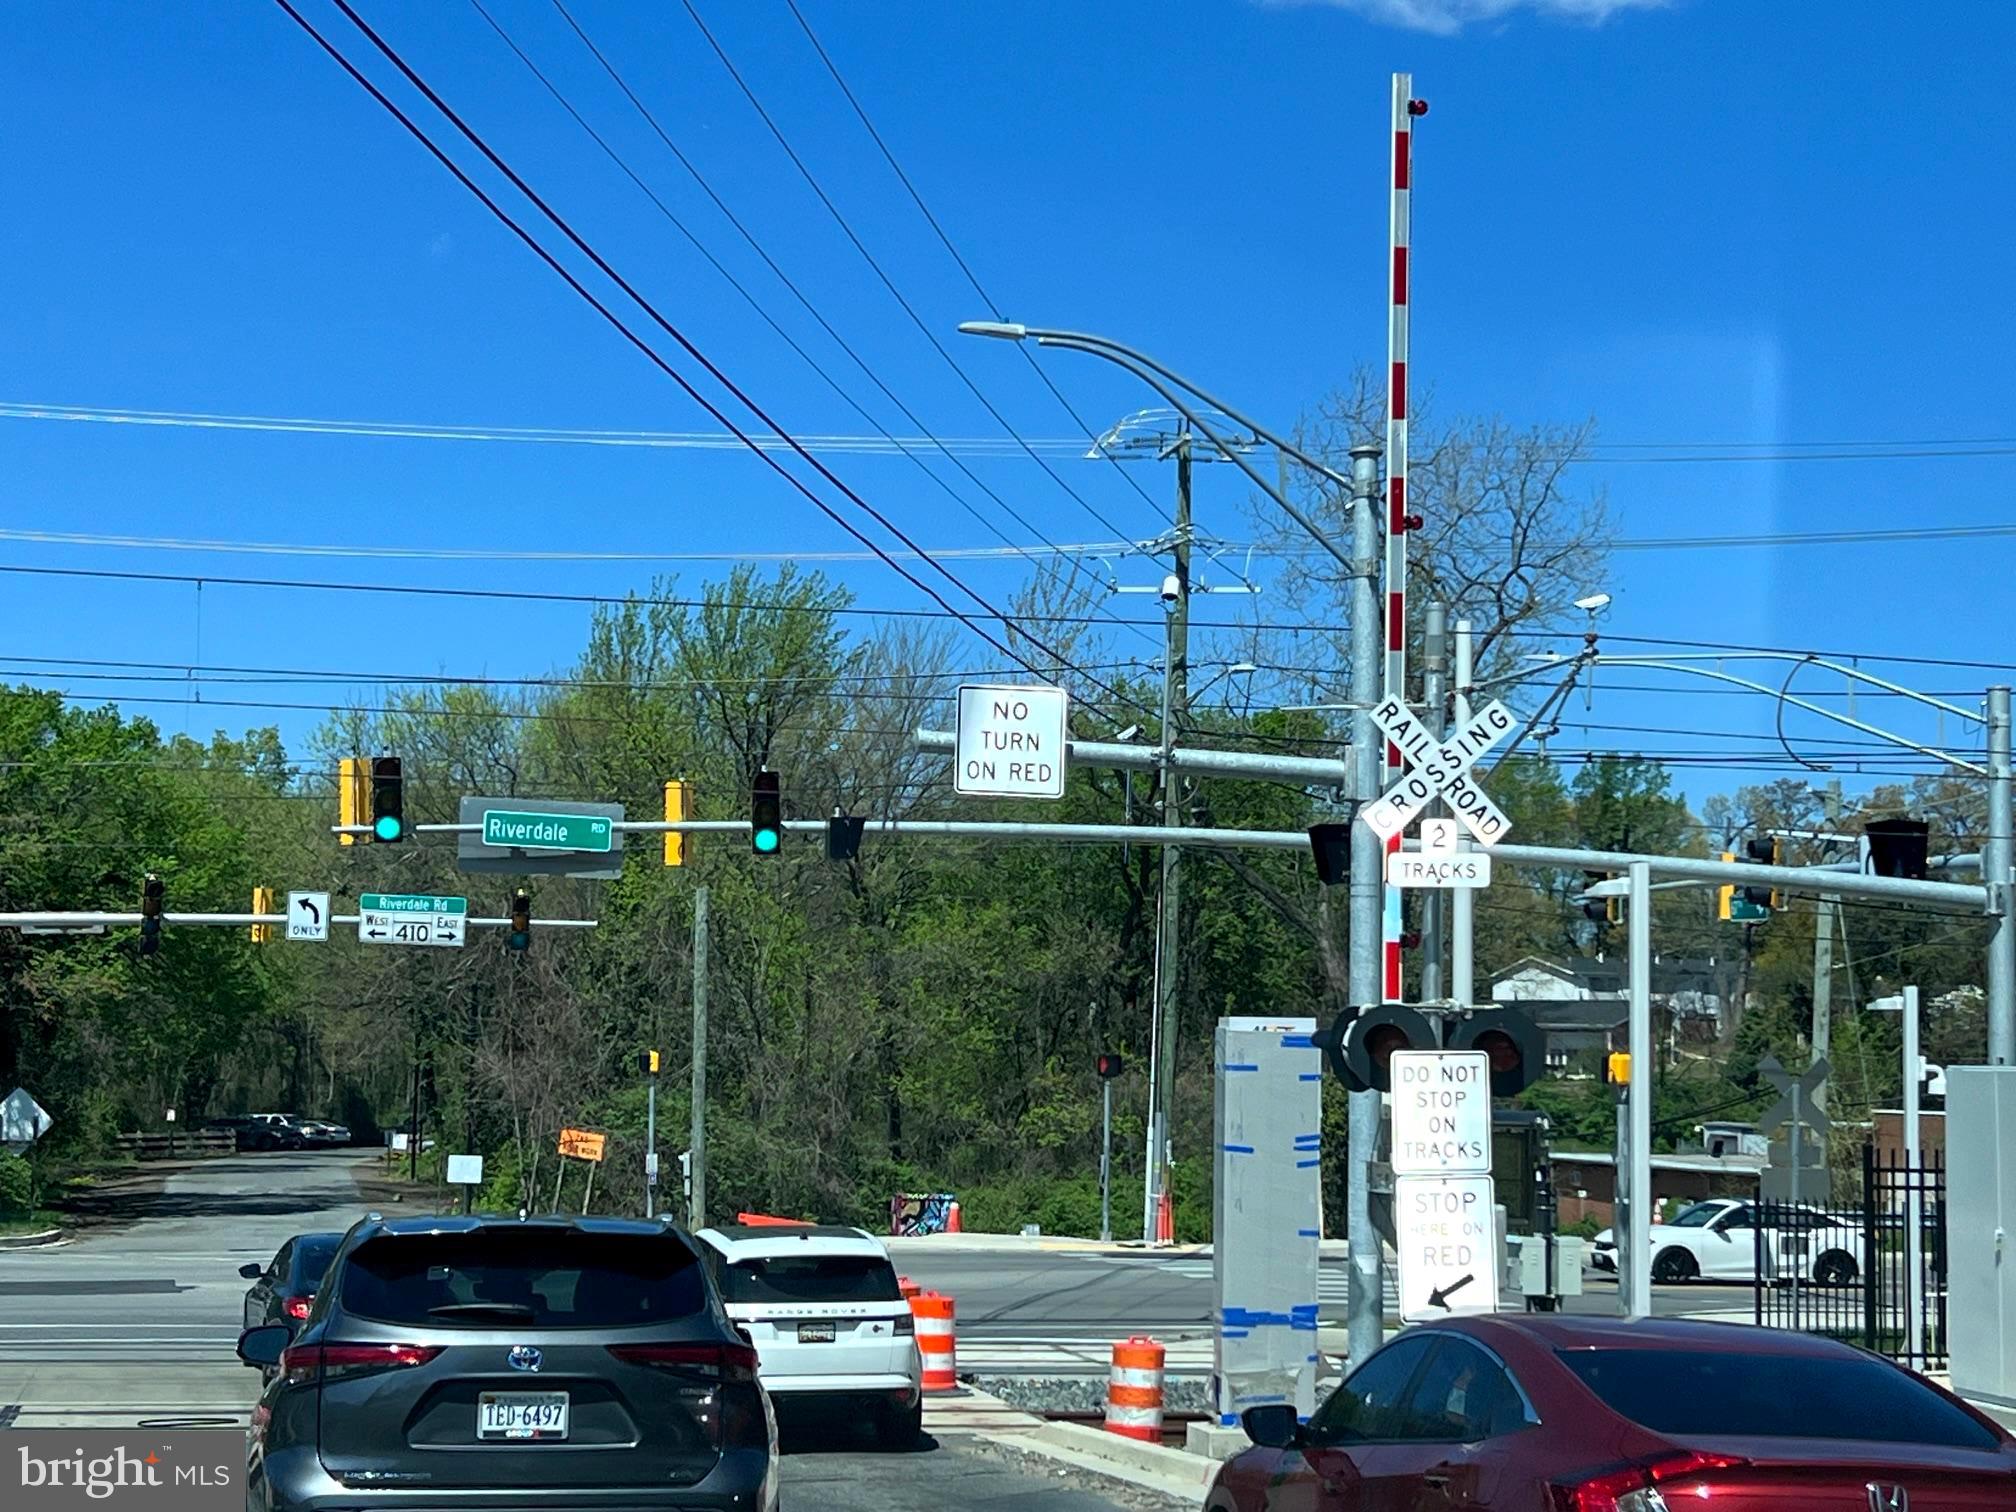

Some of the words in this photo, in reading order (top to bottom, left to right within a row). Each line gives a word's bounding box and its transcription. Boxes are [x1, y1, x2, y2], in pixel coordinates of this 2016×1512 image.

[993, 702, 1028, 720] NO
[982, 731, 1039, 751] TURN
[967, 760, 995, 780] ON
[1009, 763, 1052, 782] RED
[1374, 709, 1508, 829] CROSSING
[489, 819, 568, 841] Riverdale
[591, 823, 605, 834] RD
[1432, 825, 1446, 848] 2
[1403, 862, 1477, 879] TRACKS
[379, 897, 430, 911] Riverdale
[434, 897, 448, 911] Rd
[293, 925, 322, 936] ONLY
[395, 924, 429, 942] 410
[1403, 1066, 1430, 1083] DO
[1441, 1065, 1480, 1083] NOT
[1417, 1091, 1467, 1108] STOP
[1429, 1117, 1456, 1134] ON
[1403, 1141, 1483, 1159] TRACKS
[1415, 1192, 1477, 1213] STOP
[1463, 1221, 1484, 1236] ON
[1423, 1245, 1472, 1267] RED
[487, 1404, 562, 1427] TED-6497
